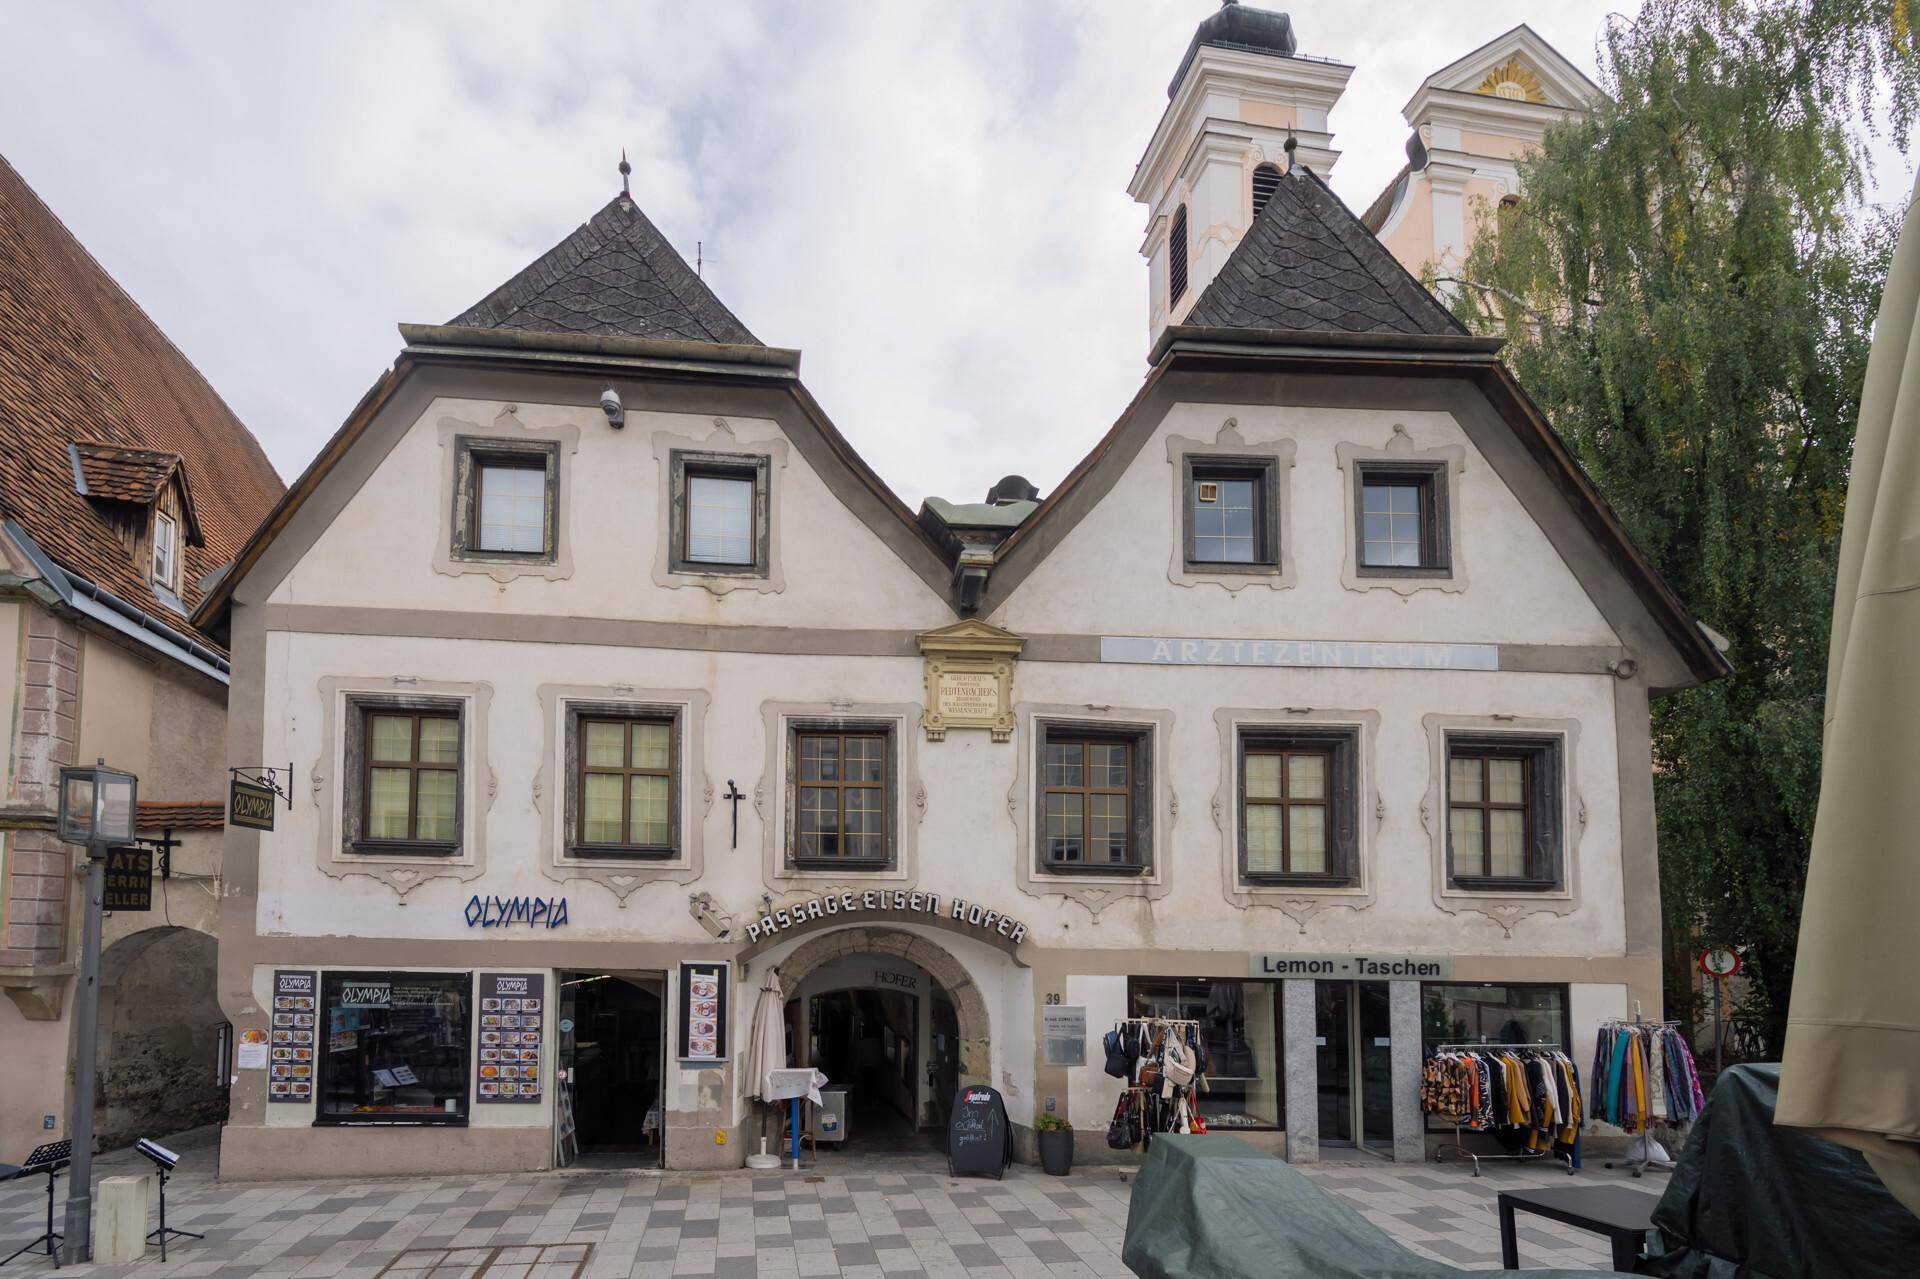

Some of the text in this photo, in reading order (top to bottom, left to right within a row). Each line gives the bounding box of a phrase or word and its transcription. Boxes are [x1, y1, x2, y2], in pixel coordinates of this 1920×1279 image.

[1152, 639, 1453, 668] ÄRZTEZENTRUM
[234, 792, 272, 819] OLYMPIA
[104, 874, 150, 888] ERRN
[105, 892, 149, 906] ELLER
[464, 895, 568, 928] OLYMPIA
[745, 889, 1029, 944] PASSAGE EISEN HOFER
[1263, 956, 1334, 973] Lemon
[1355, 957, 1441, 976] Taschen
[279, 978, 312, 989] OLYMPIA
[497, 980, 528, 991] OLYMPIA
[874, 970, 917, 989] HOFER
[342, 987, 391, 1004] OLYMPIA
[1045, 992, 1061, 1005] 39
